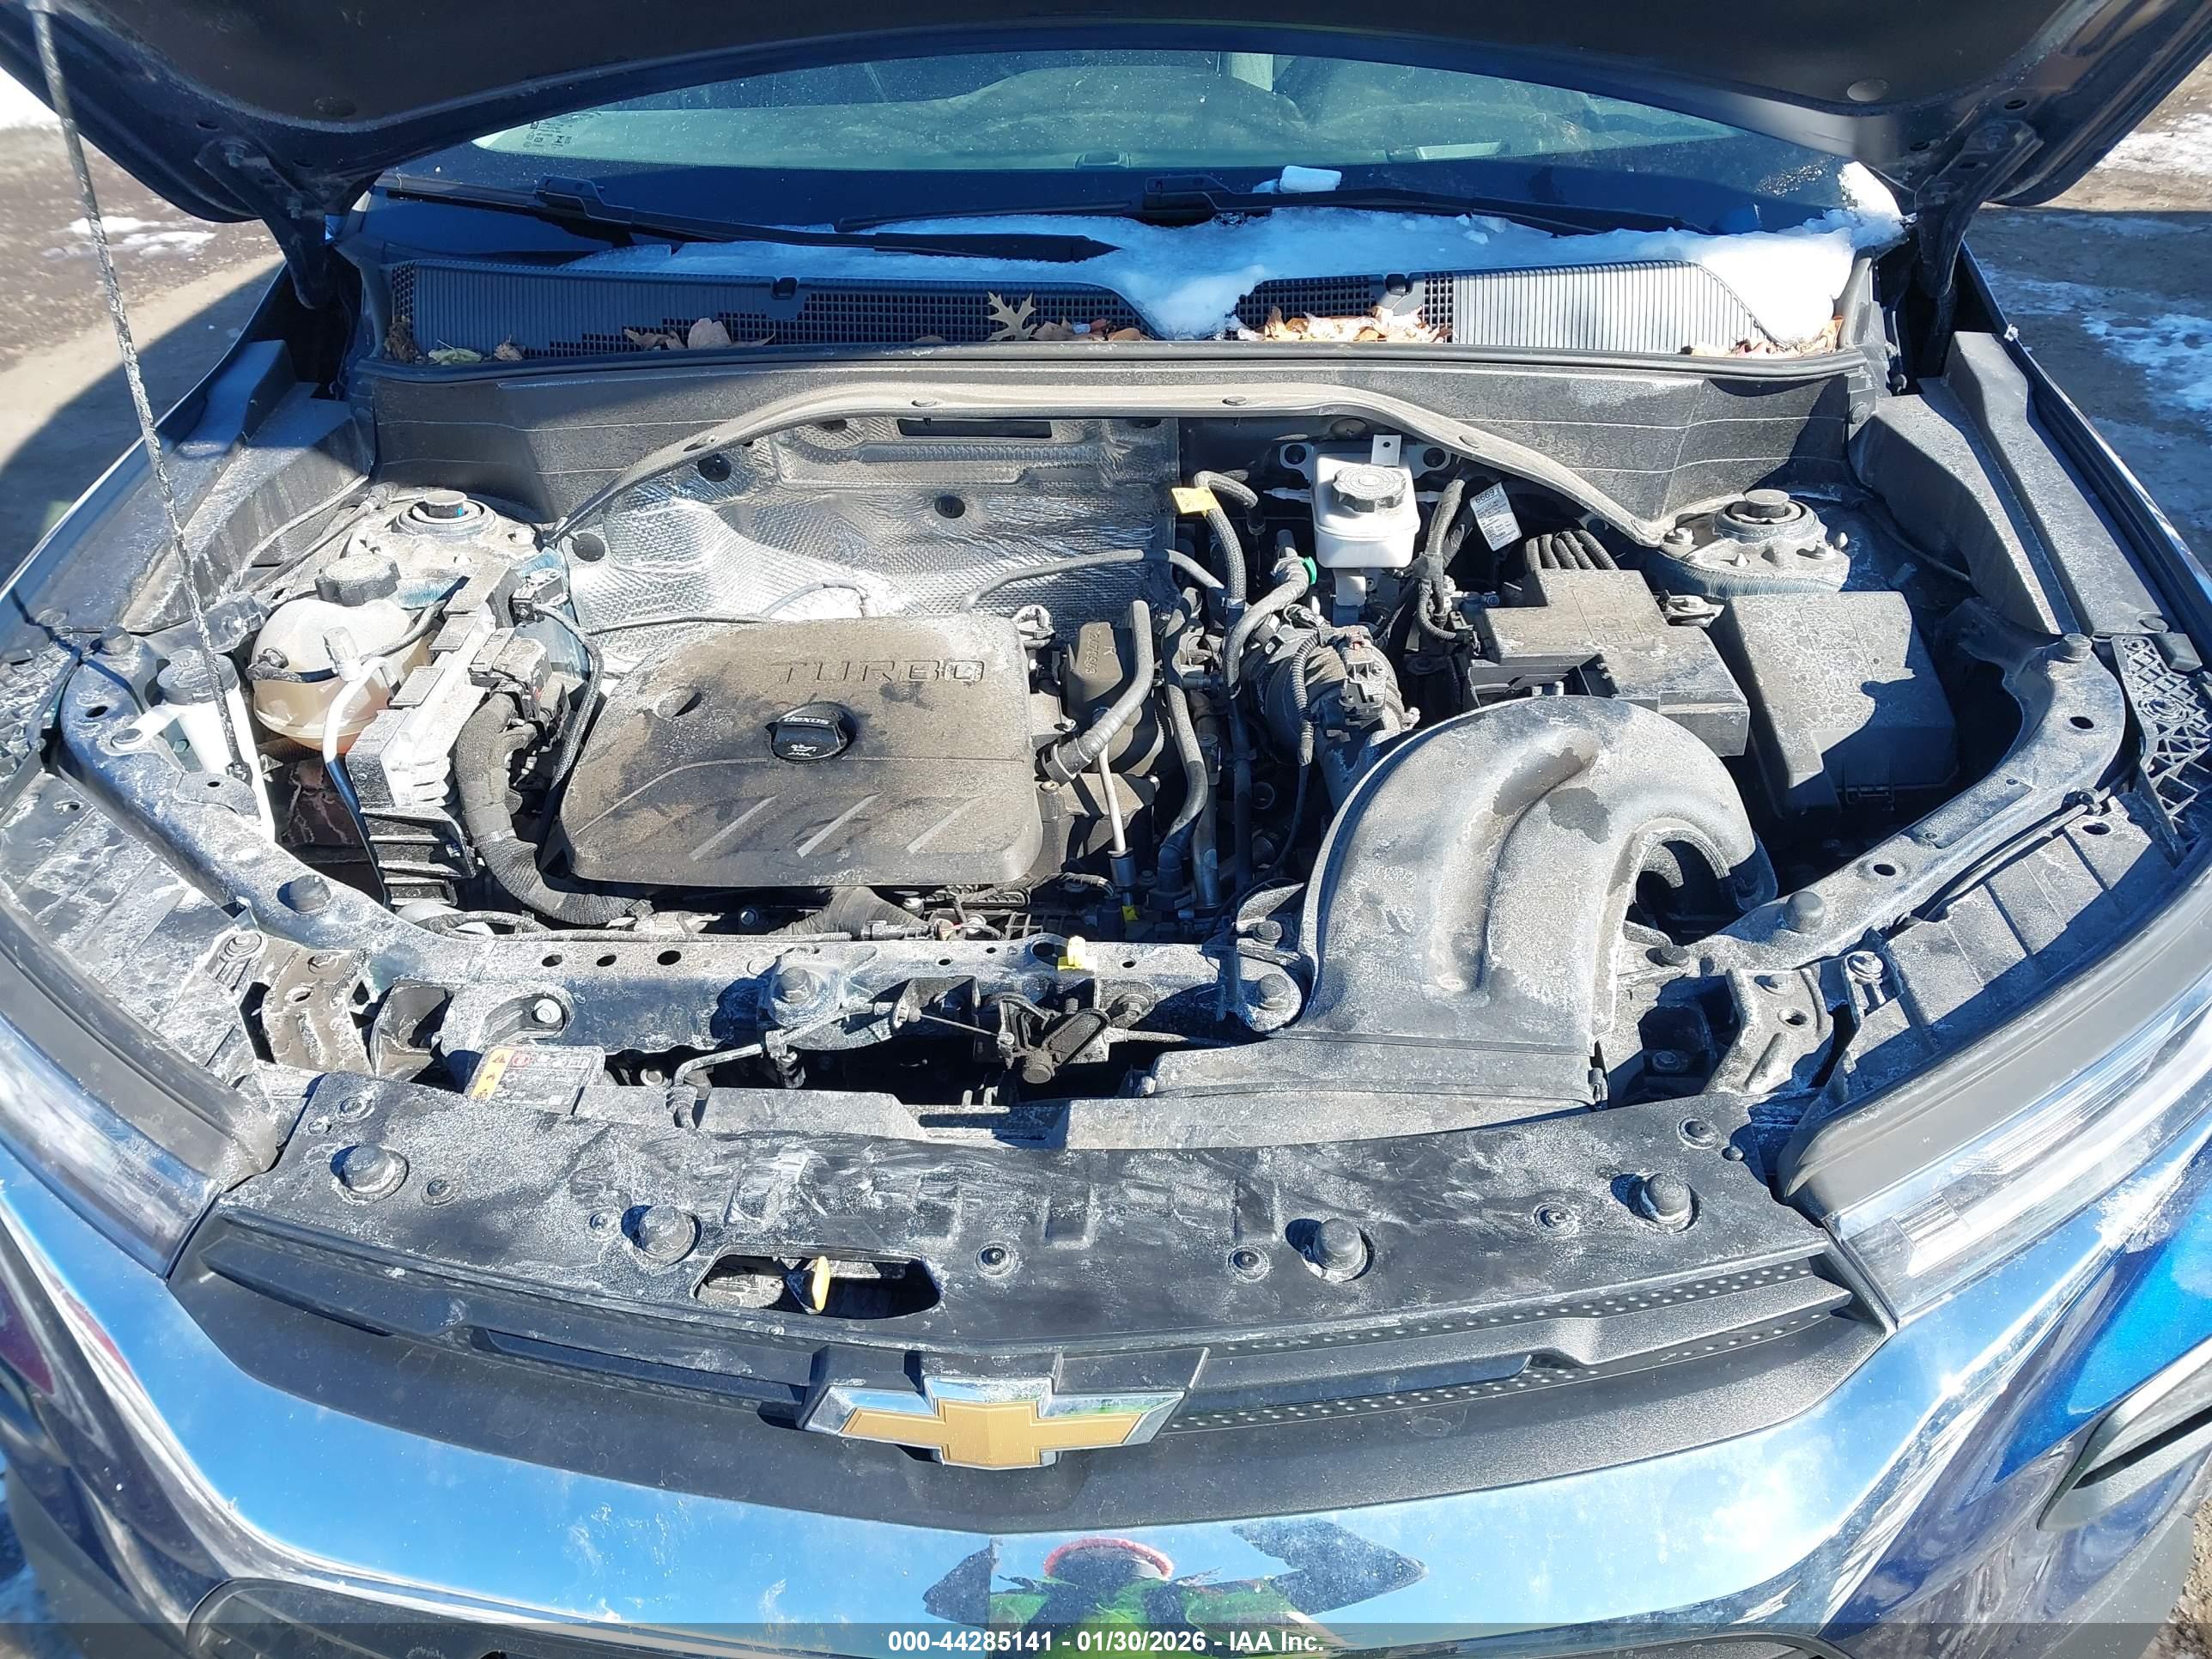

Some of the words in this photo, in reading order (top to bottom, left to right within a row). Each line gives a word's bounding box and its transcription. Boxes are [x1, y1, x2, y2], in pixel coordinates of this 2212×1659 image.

[1475, 488, 1495, 504] 6669
[769, 660, 985, 684] TURBO
[783, 716, 831, 726] dexos
